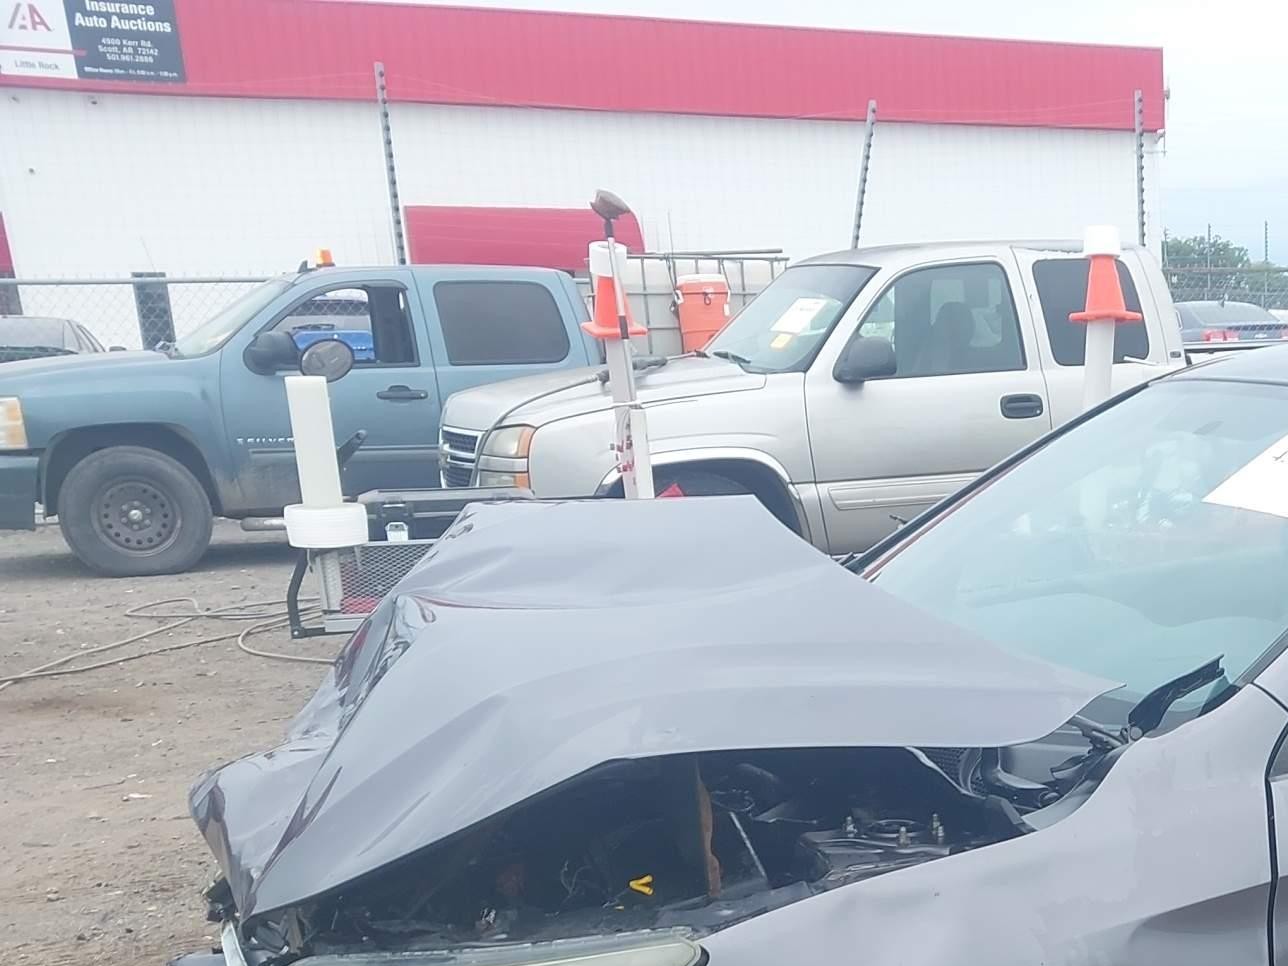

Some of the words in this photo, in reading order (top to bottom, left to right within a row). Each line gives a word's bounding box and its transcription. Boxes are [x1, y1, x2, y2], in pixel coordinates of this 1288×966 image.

[85, 0, 155, 16] Insurance
[74, 12, 107, 28] Auto
[111, 15, 172, 33] Auctions
